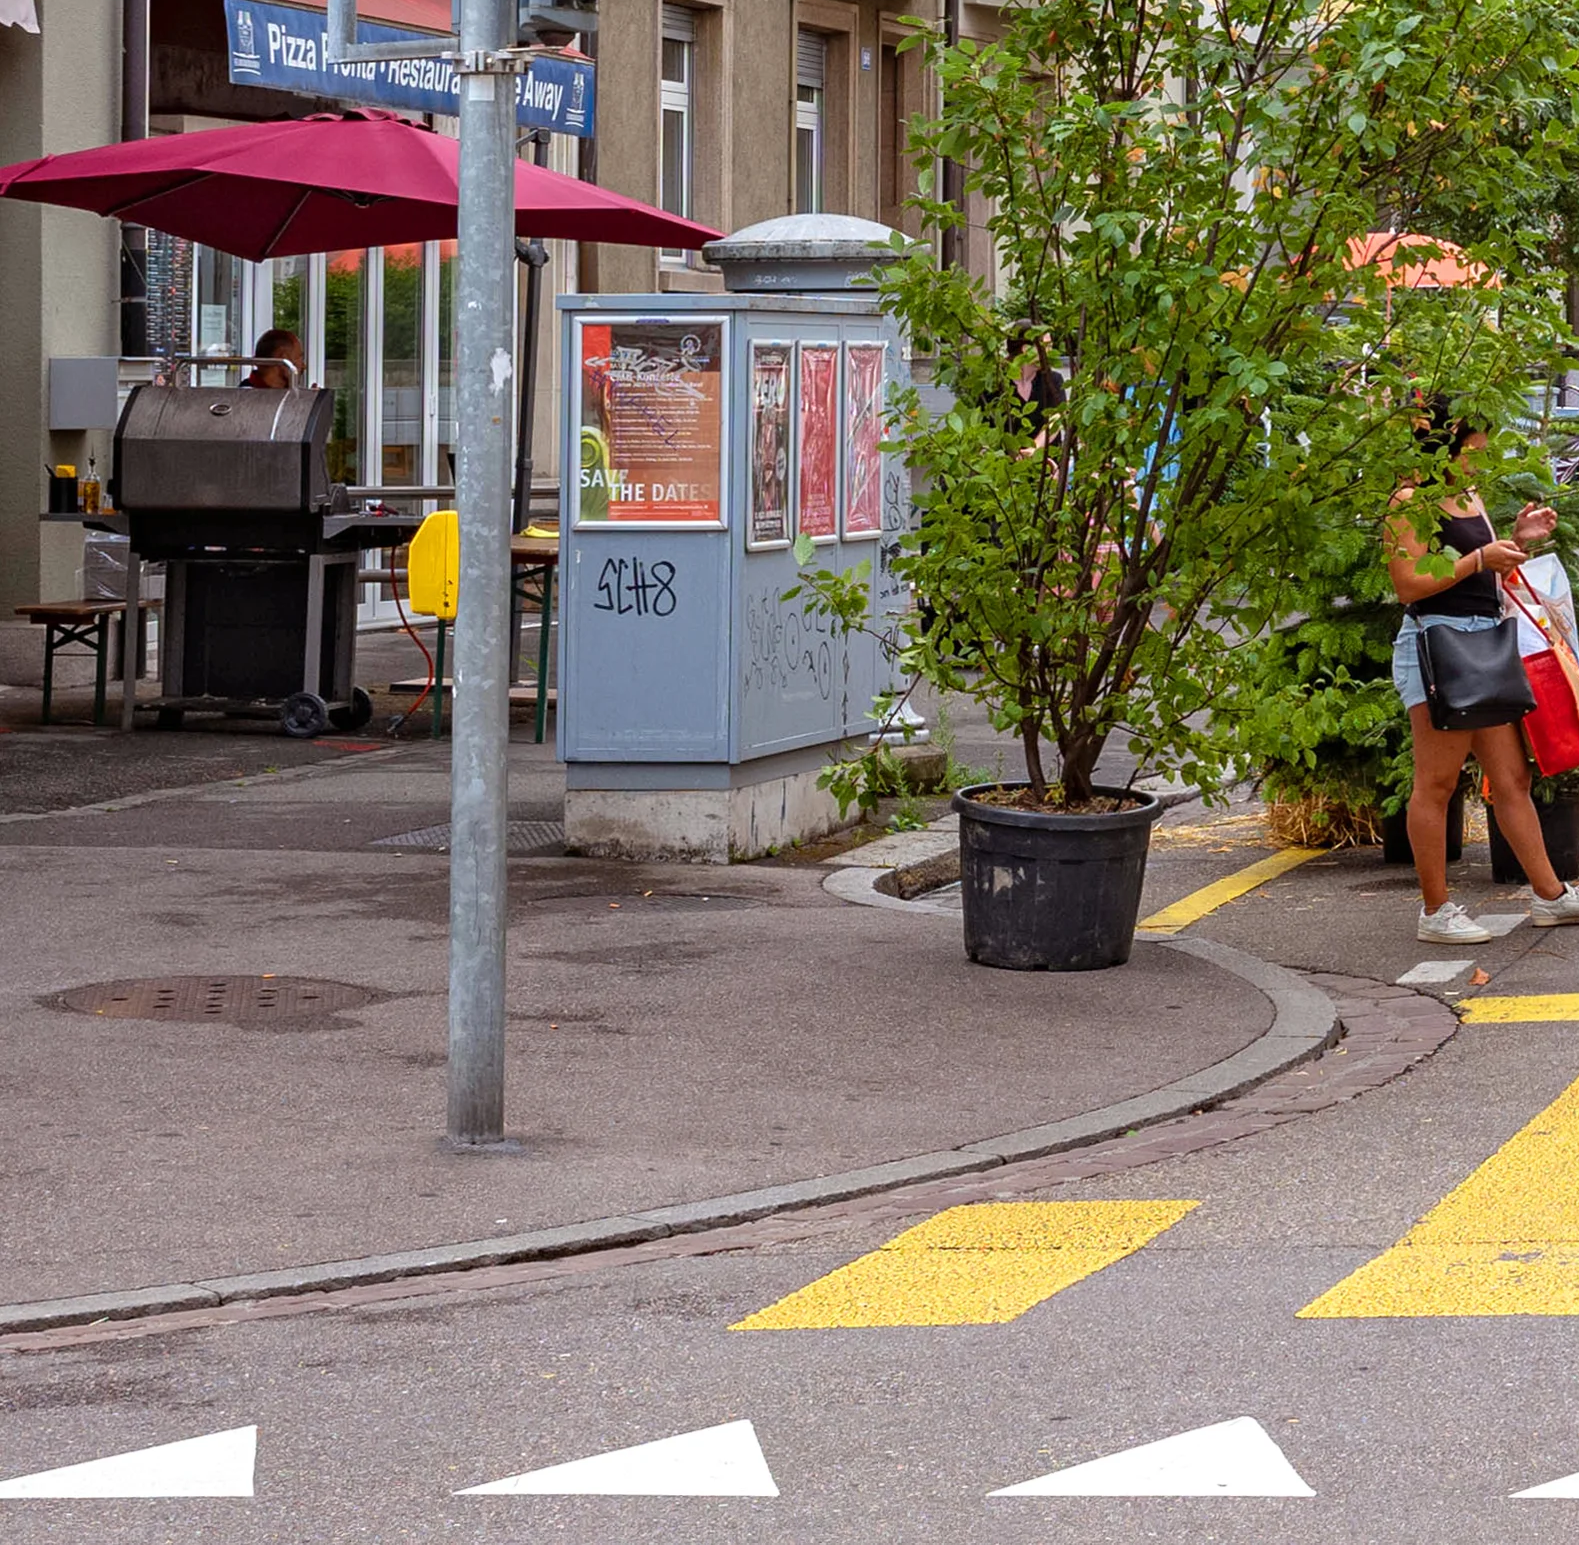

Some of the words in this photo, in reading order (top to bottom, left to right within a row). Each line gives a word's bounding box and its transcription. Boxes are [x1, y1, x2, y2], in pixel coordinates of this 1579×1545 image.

[267, 23, 316, 71] Pizza
[523, 70, 563, 121] Away
[580, 469, 629, 488] SAVE
[609, 484, 645, 502] THE
[652, 484, 711, 502] DATES
